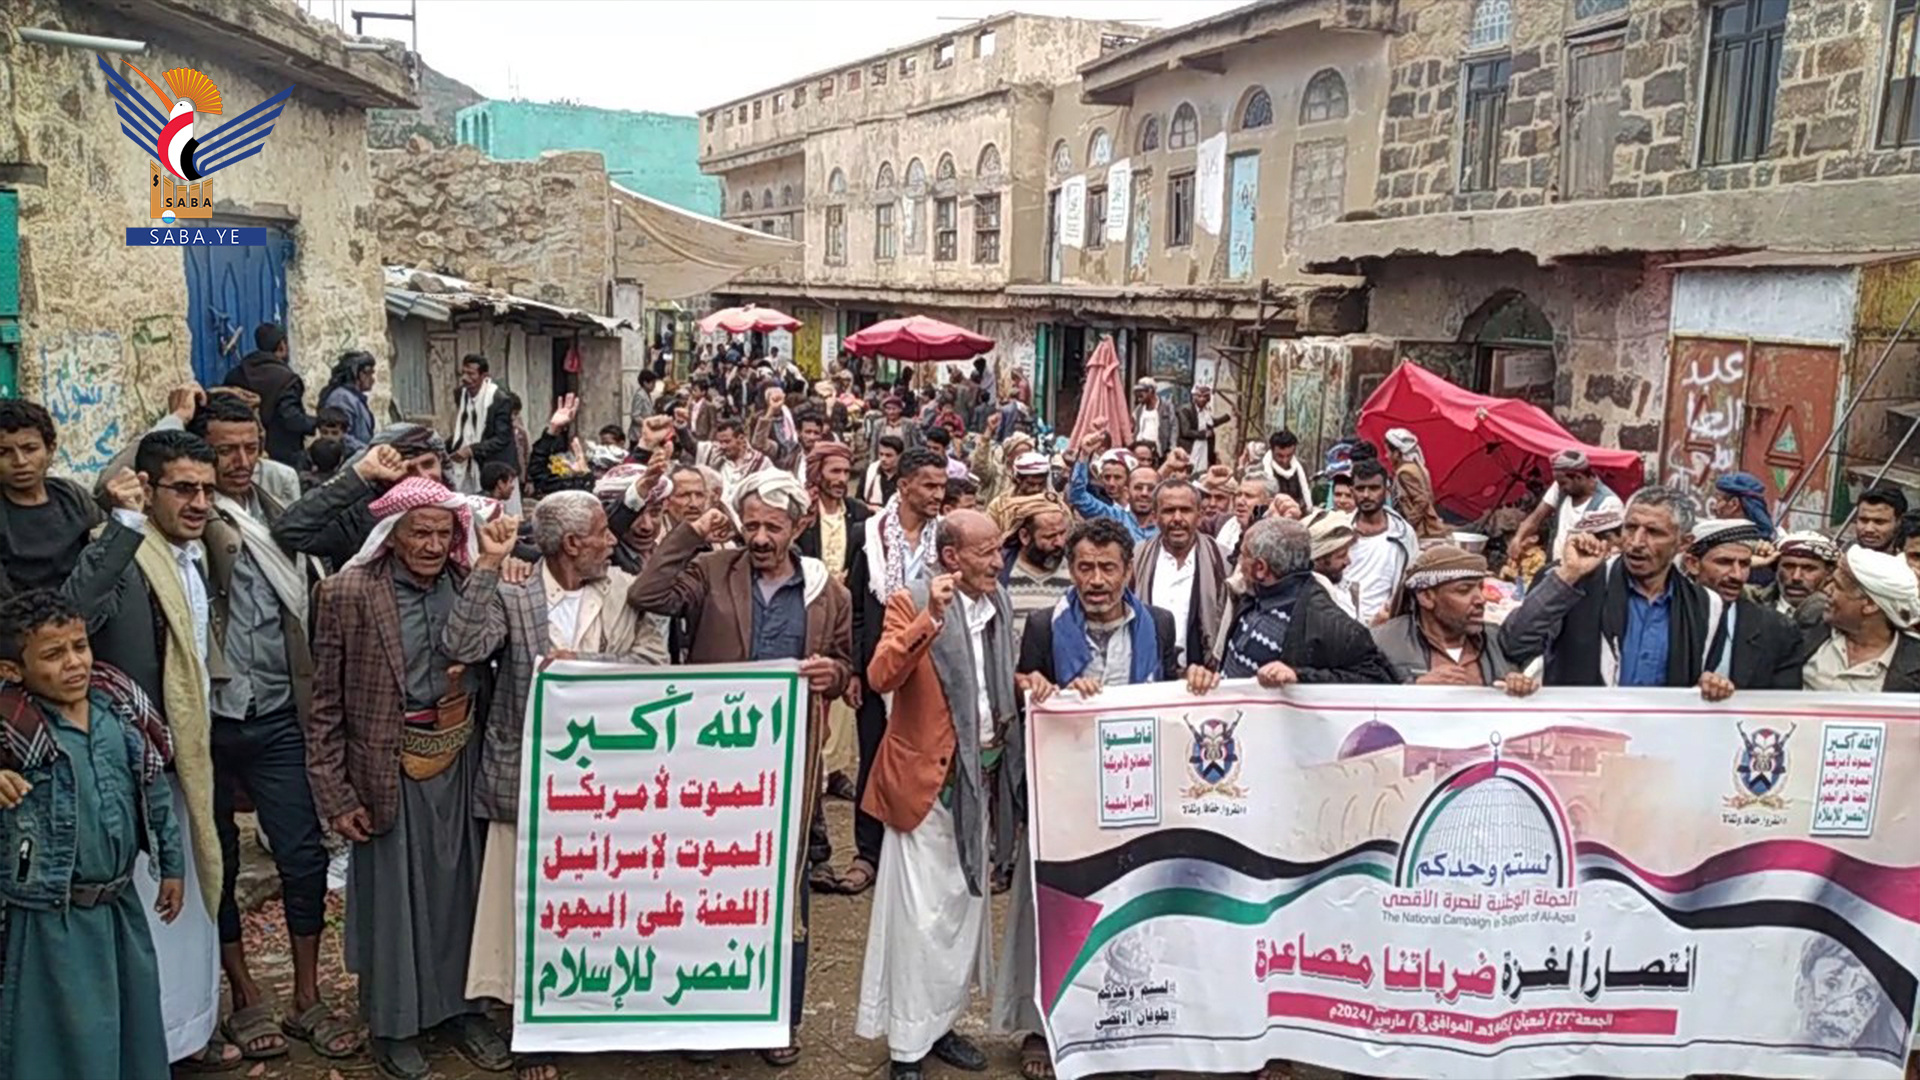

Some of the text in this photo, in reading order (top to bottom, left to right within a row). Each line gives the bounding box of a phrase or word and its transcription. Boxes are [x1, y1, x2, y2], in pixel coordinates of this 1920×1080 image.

[545, 684, 782, 770] الله أكبر
[545, 765, 777, 819] الموت لأمريكا
[543, 831, 773, 880] الموت لإسرائيل
[1416, 852, 1552, 886] لستم وحدكم
[540, 888, 770, 938] اللعنة على اليهود
[1382, 889, 1578, 914] الحملة الوطنية لنصرة الأقصى
[1382, 911, 1399, 923] The
[1402, 912, 1440, 925] National
[1443, 913, 1491, 929] Campaign
[539, 939, 767, 1011] النصر للإسلام
[1255, 932, 1375, 988] متصاعدة
[1383, 946, 1497, 1004] ضرباتنا
[1501, 945, 1574, 1003] لغزة
